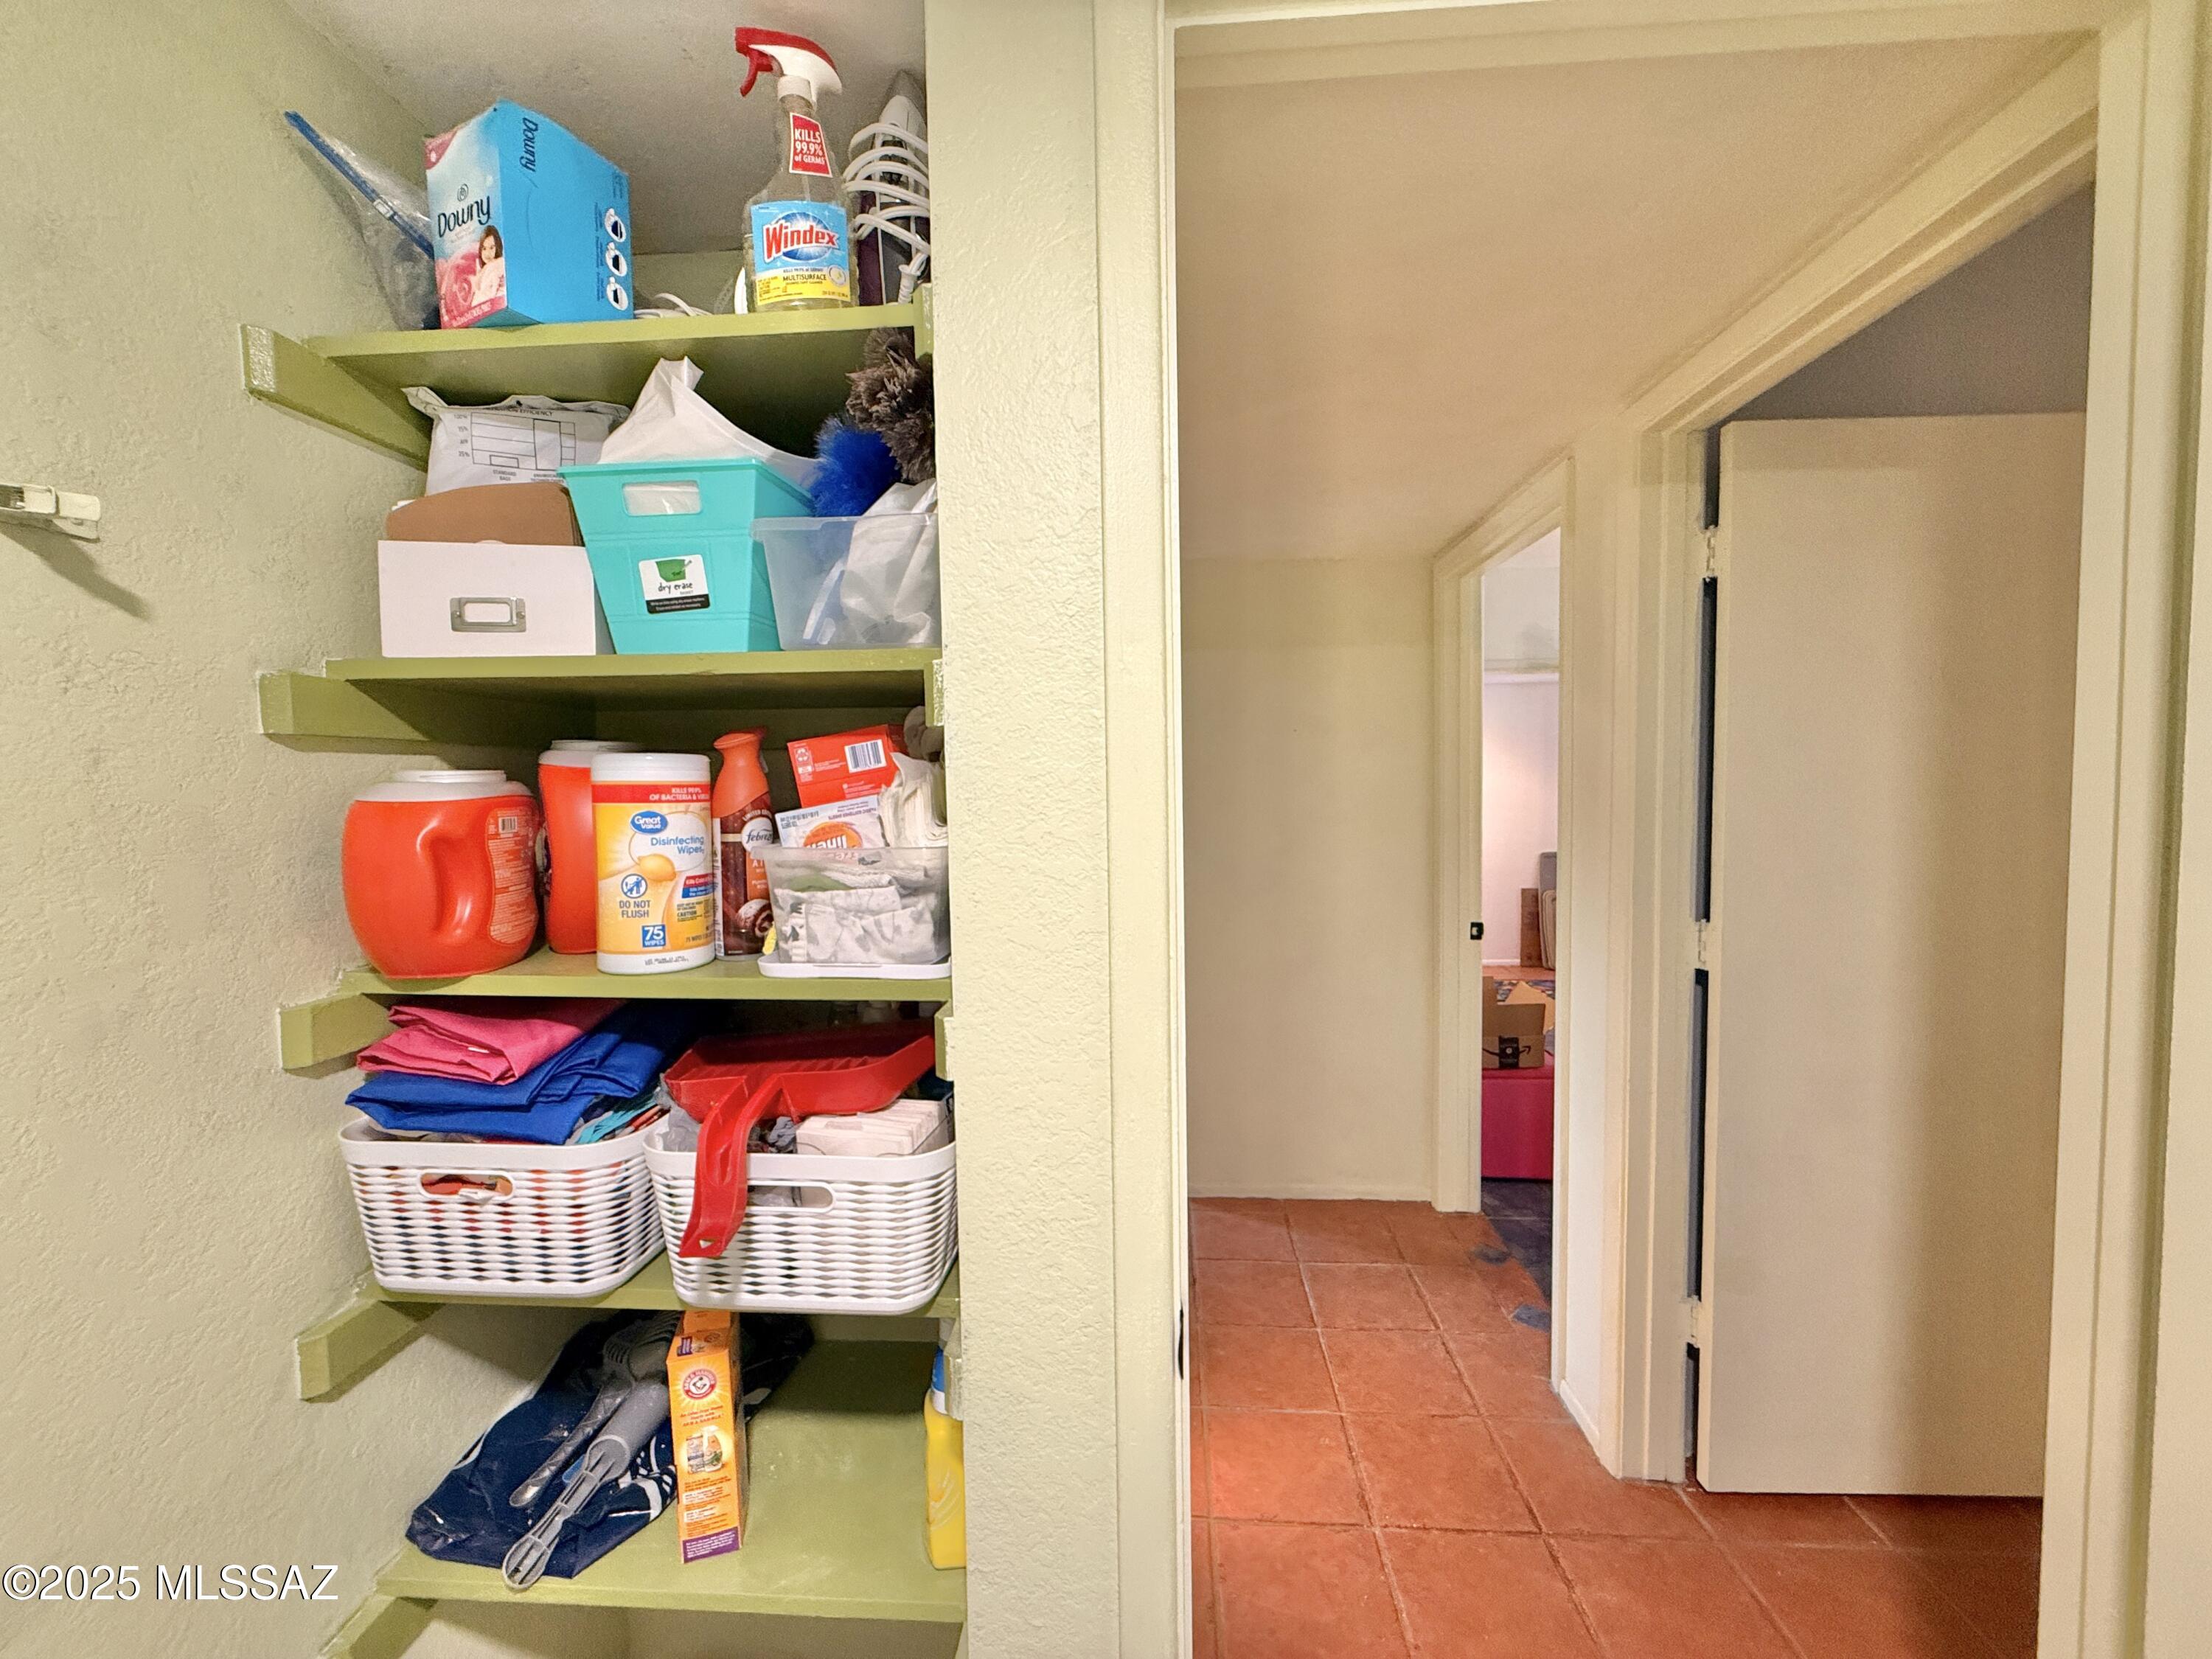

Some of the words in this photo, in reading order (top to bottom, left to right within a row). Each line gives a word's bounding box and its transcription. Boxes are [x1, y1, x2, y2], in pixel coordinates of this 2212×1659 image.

[794, 128, 821, 143] KILLS
[520, 118, 538, 172] Downy
[795, 141, 824, 156] 99.9%
[794, 153, 802, 161] of
[803, 155, 825, 165] GERMS
[438, 195, 491, 238] Downy
[764, 222, 838, 260] Windex
[658, 582, 671, 594] dry
[674, 582, 693, 591] erase
[634, 815, 661, 825] Great
[641, 821, 661, 830] Value
[650, 835, 704, 846] Disinfecting
[677, 846, 702, 855] Wipes
[619, 900, 630, 908] DO
[633, 900, 650, 908] NOT
[621, 910, 650, 918] FLUSH
[644, 925, 664, 940] 75
